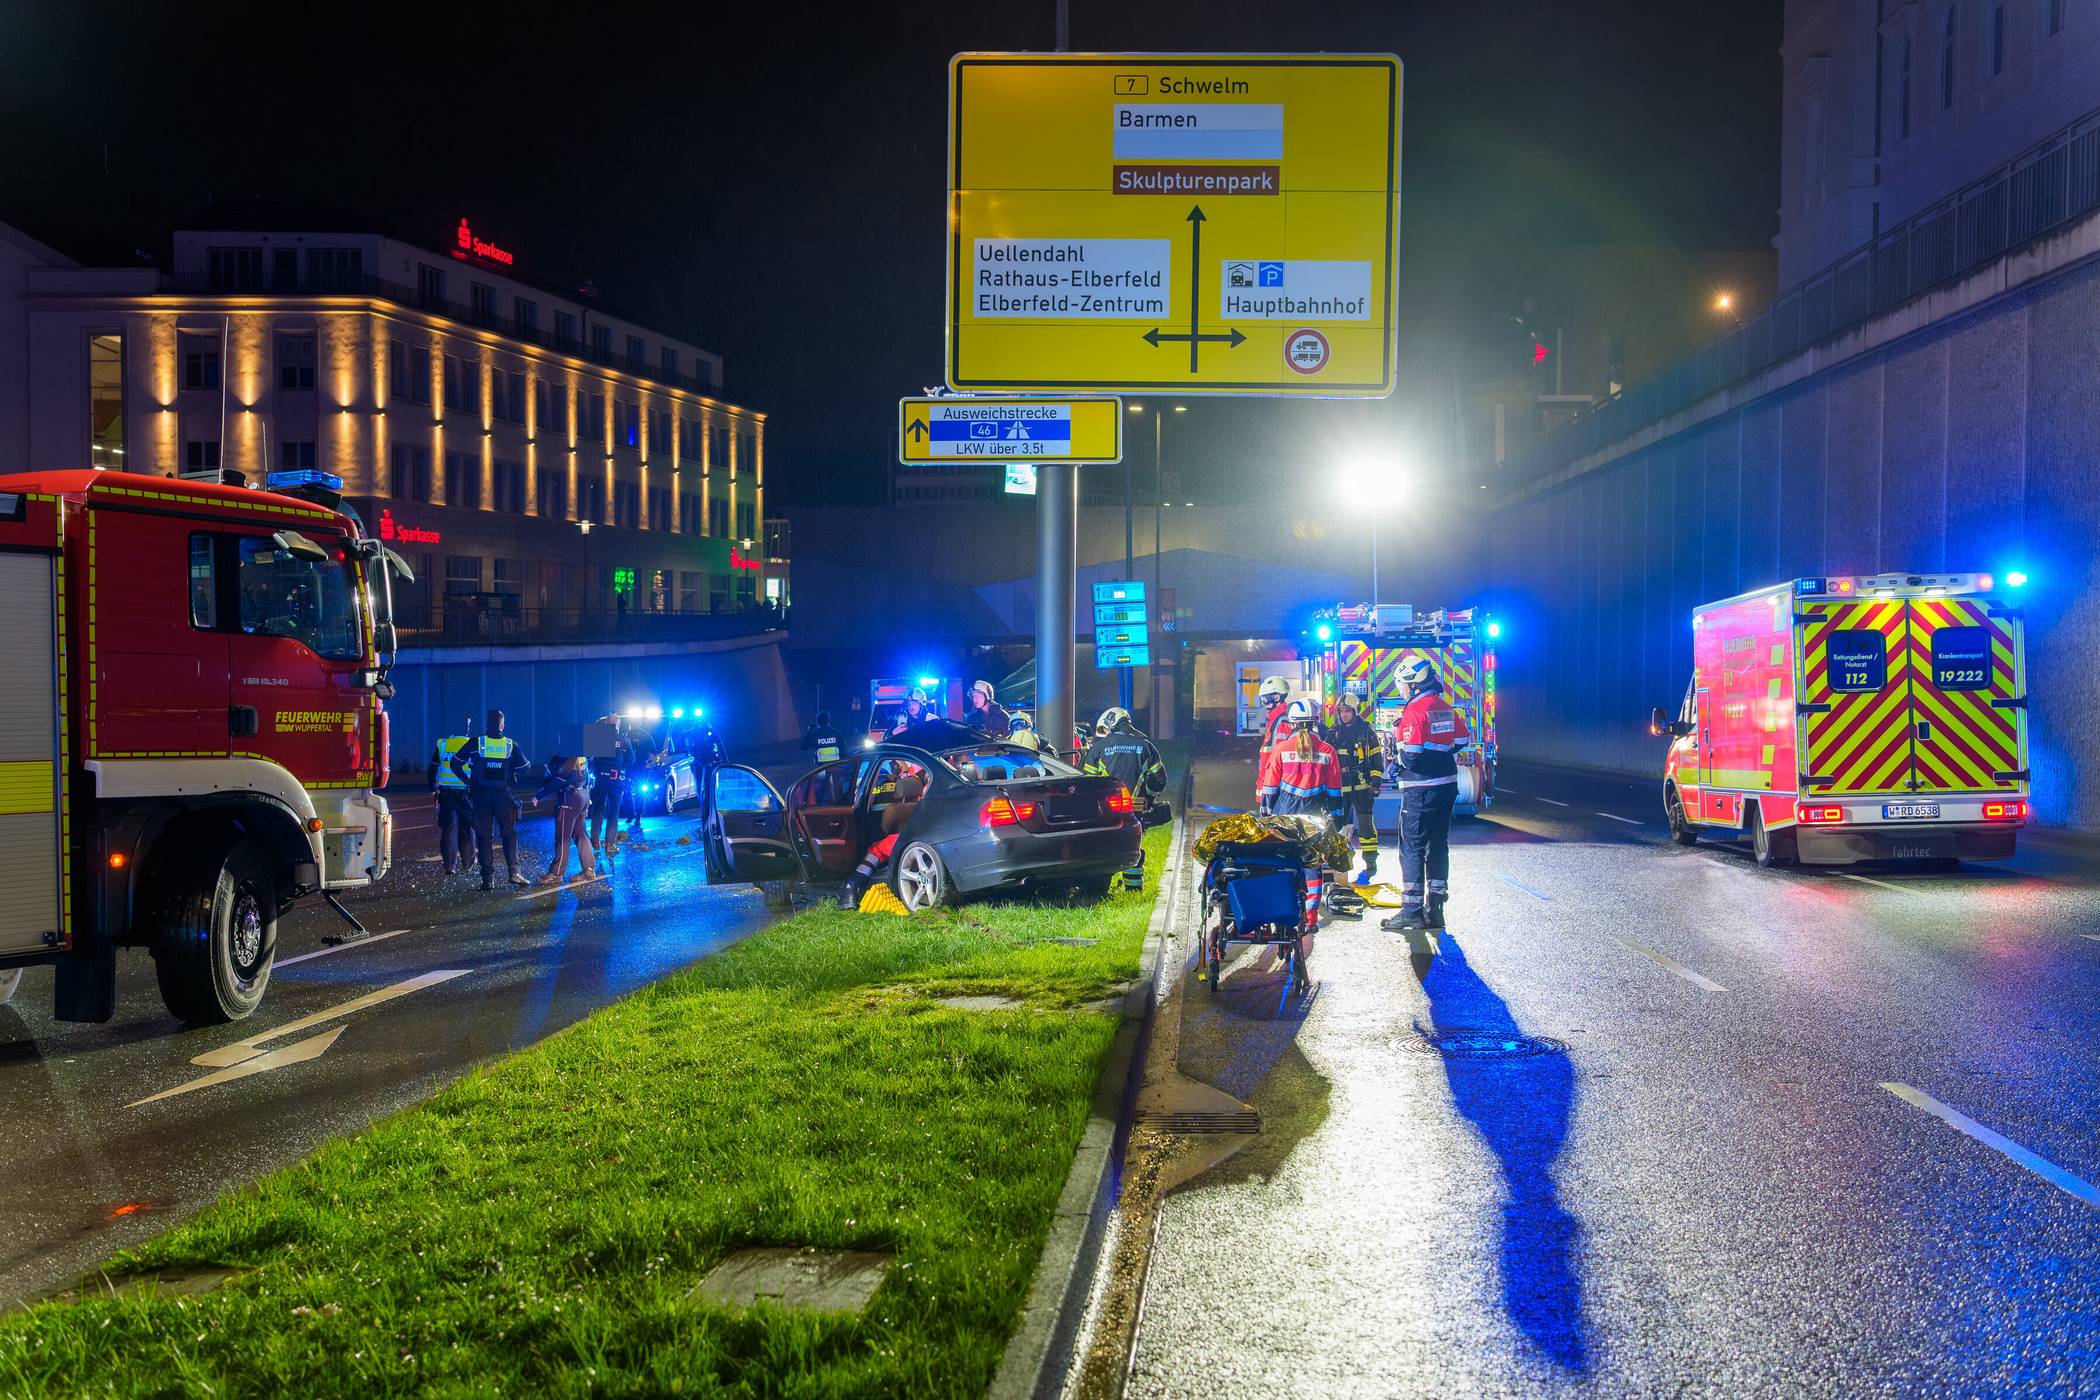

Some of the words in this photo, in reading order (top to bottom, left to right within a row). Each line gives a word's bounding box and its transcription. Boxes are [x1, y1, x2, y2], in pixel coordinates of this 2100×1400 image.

[1127, 79, 1136, 92] 7
[1159, 77, 1249, 94] Schwelm
[1119, 110, 1197, 128] Barmen
[1119, 171, 1273, 194] Skulpturenpark
[473, 237, 513, 265] Sparkasse
[979, 245, 1085, 262] Uellendahl
[979, 269, 1161, 288] Rathaus-Elberfeld
[979, 294, 1163, 312] Elberfeld-Zentrum
[1227, 296, 1365, 318] Hauptbahnhof
[943, 406, 1057, 420] Ausweichstrecke
[977, 425, 991, 436] 46
[956, 443, 985, 455] LKW
[989, 442, 1017, 455] über
[397, 524, 440, 544] Sparkasse
[1833, 653, 1873, 661] Rettungsdienst
[1845, 672, 1868, 685] 112
[275, 712, 342, 723] FEUERWEHR
[294, 724, 333, 732] WUPPERTAL
[817, 737, 836, 745] POLIZEI
[1901, 806, 1914, 816] RD
[1915, 806, 1938, 816] 6538
[1892, 845, 1931, 858] fahrtec
